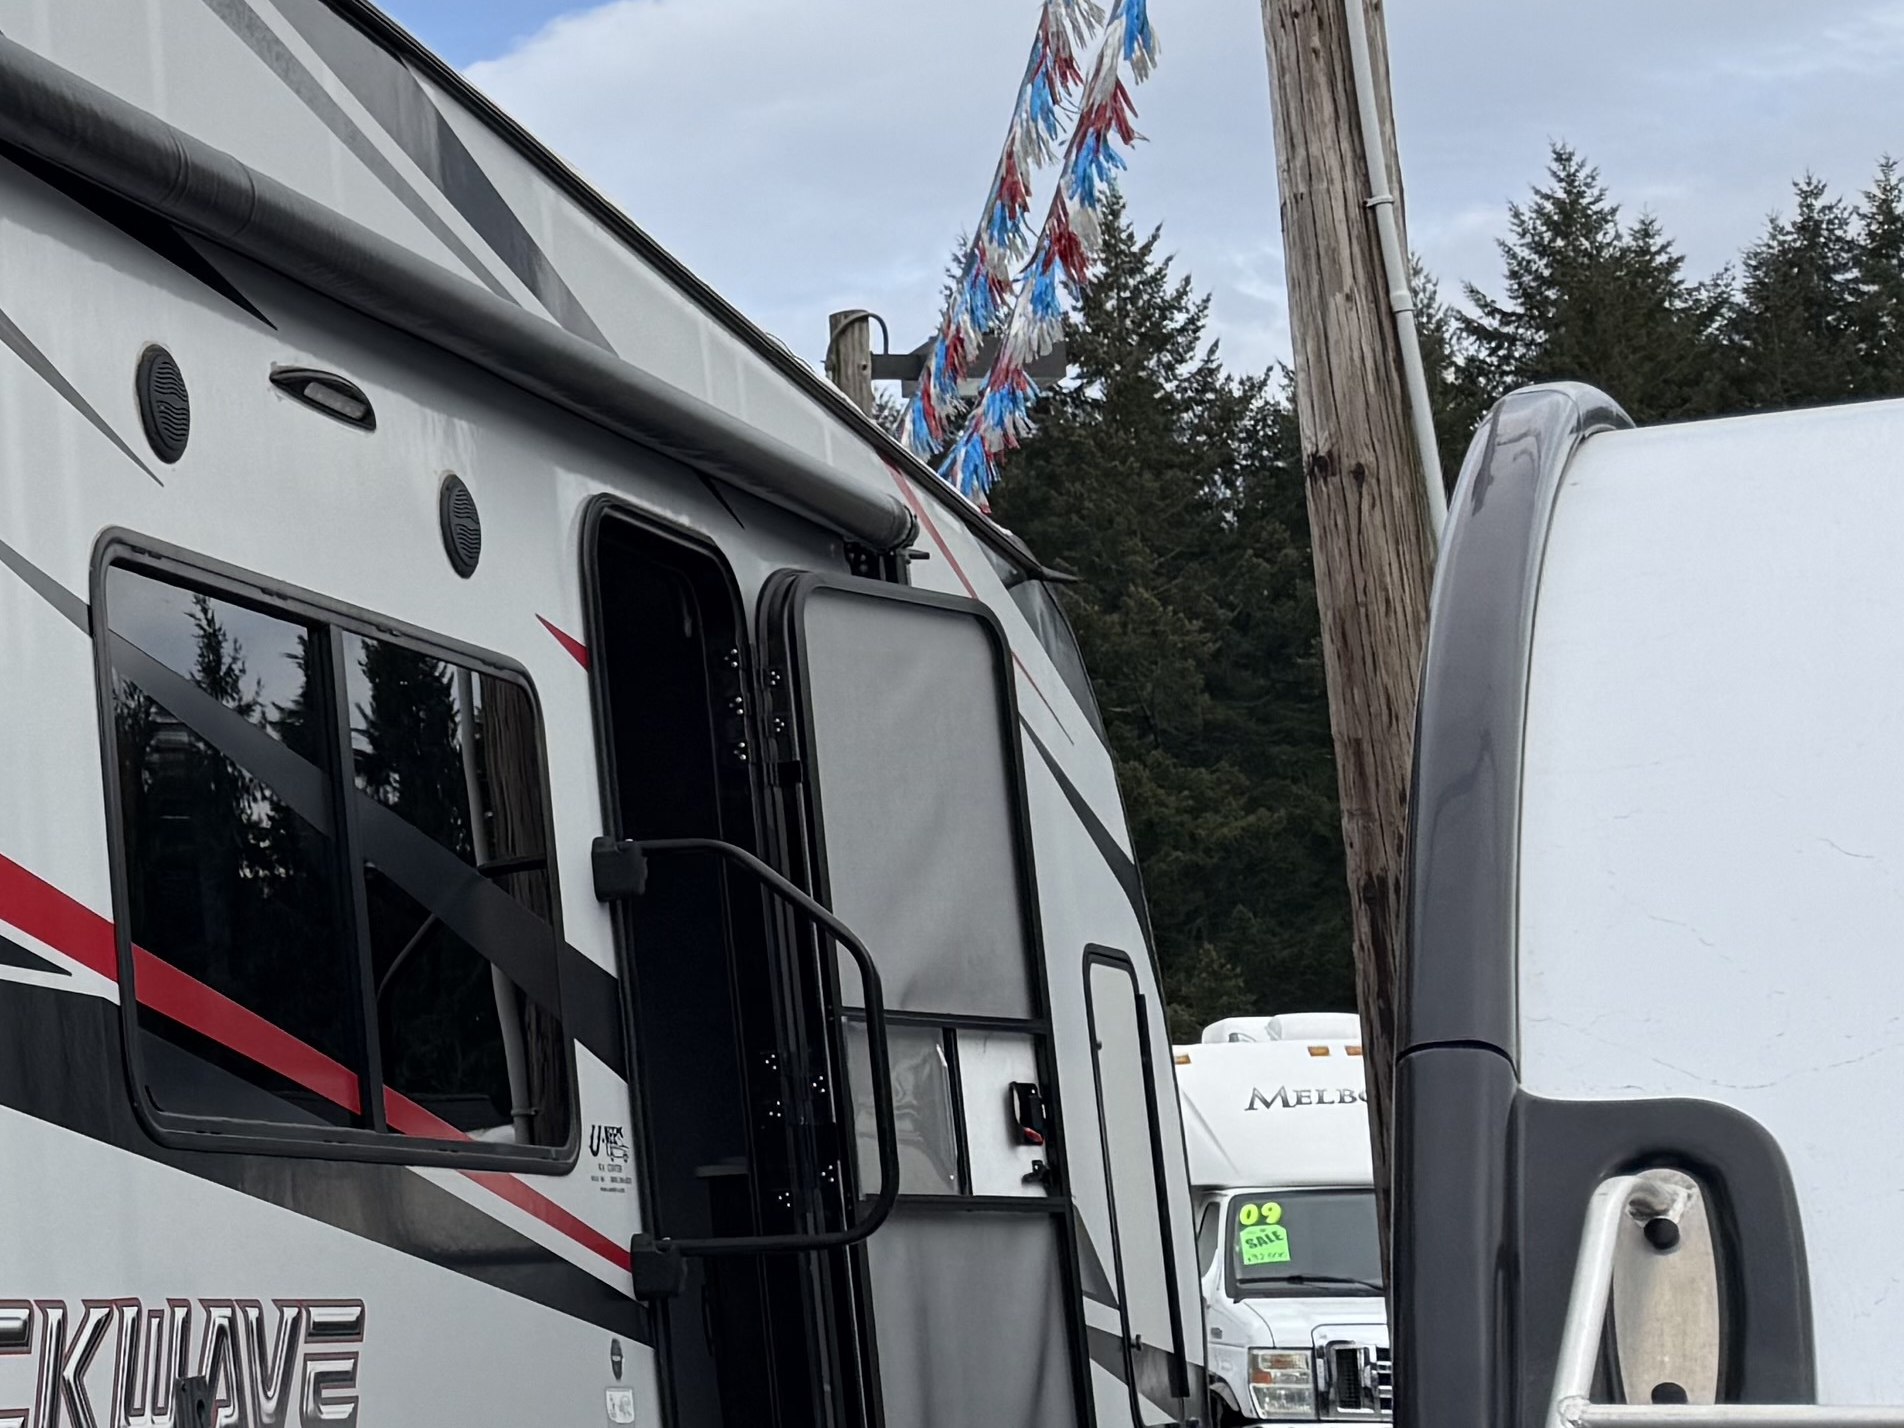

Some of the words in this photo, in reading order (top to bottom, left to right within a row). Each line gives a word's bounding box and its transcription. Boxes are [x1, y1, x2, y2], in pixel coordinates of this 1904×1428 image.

[1245, 1085, 1368, 1111] MELB
[1240, 1202, 1282, 1226] 09
[1245, 1230, 1284, 1250] SALE
